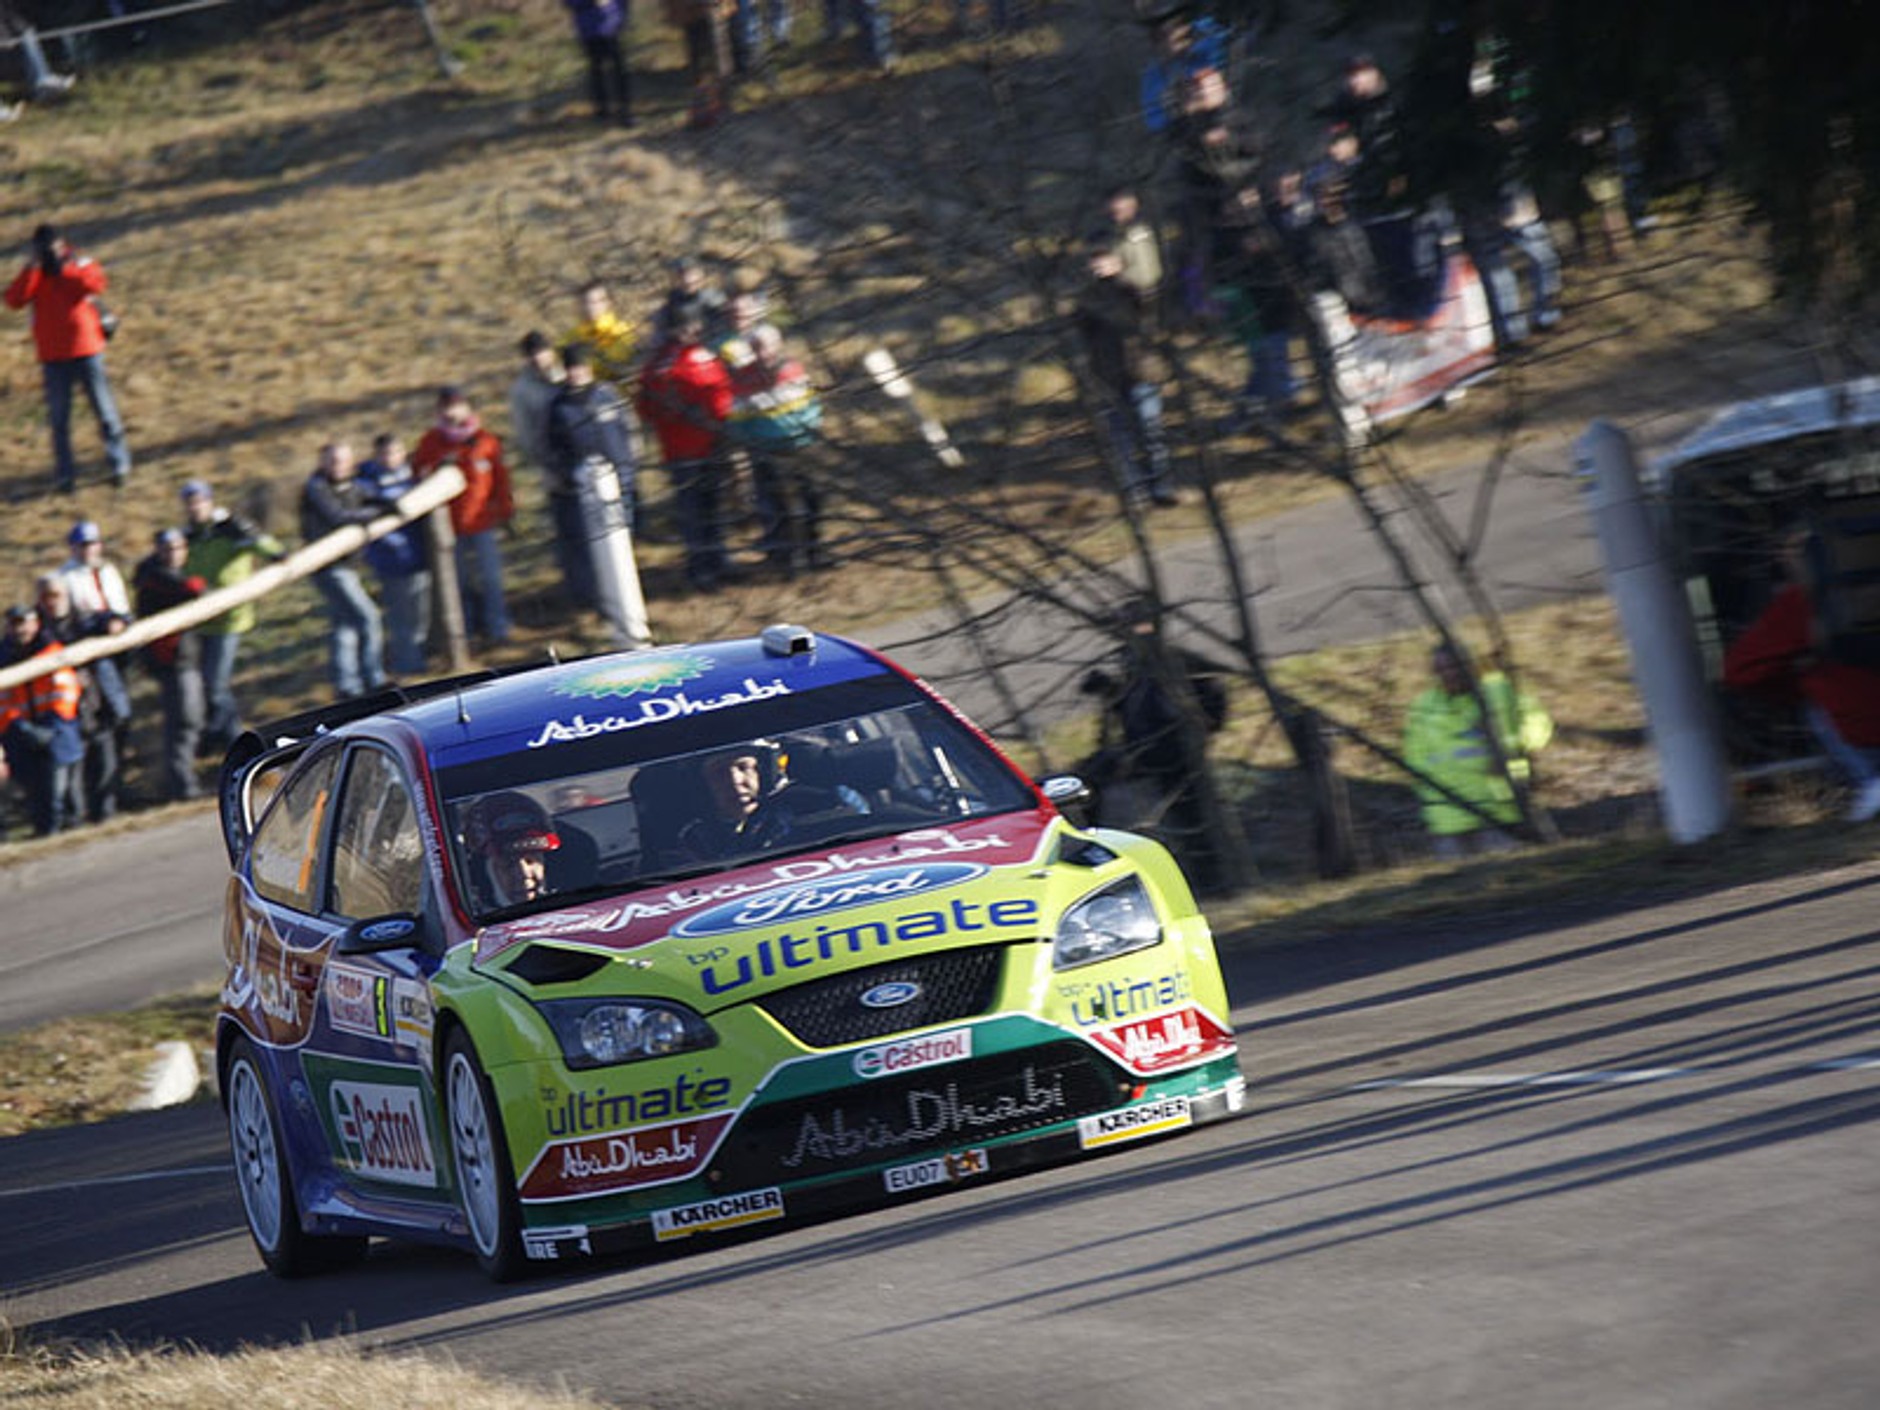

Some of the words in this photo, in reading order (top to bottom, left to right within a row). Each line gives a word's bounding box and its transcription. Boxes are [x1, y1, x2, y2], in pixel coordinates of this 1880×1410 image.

[733, 869, 929, 925] Ford
[700, 898, 1038, 996] ultimate
[884, 1033, 963, 1071] Castrol
[353, 1093, 432, 1172] Castrol
[547, 1073, 731, 1136] ultimate
[890, 1162, 940, 1189] EU07
